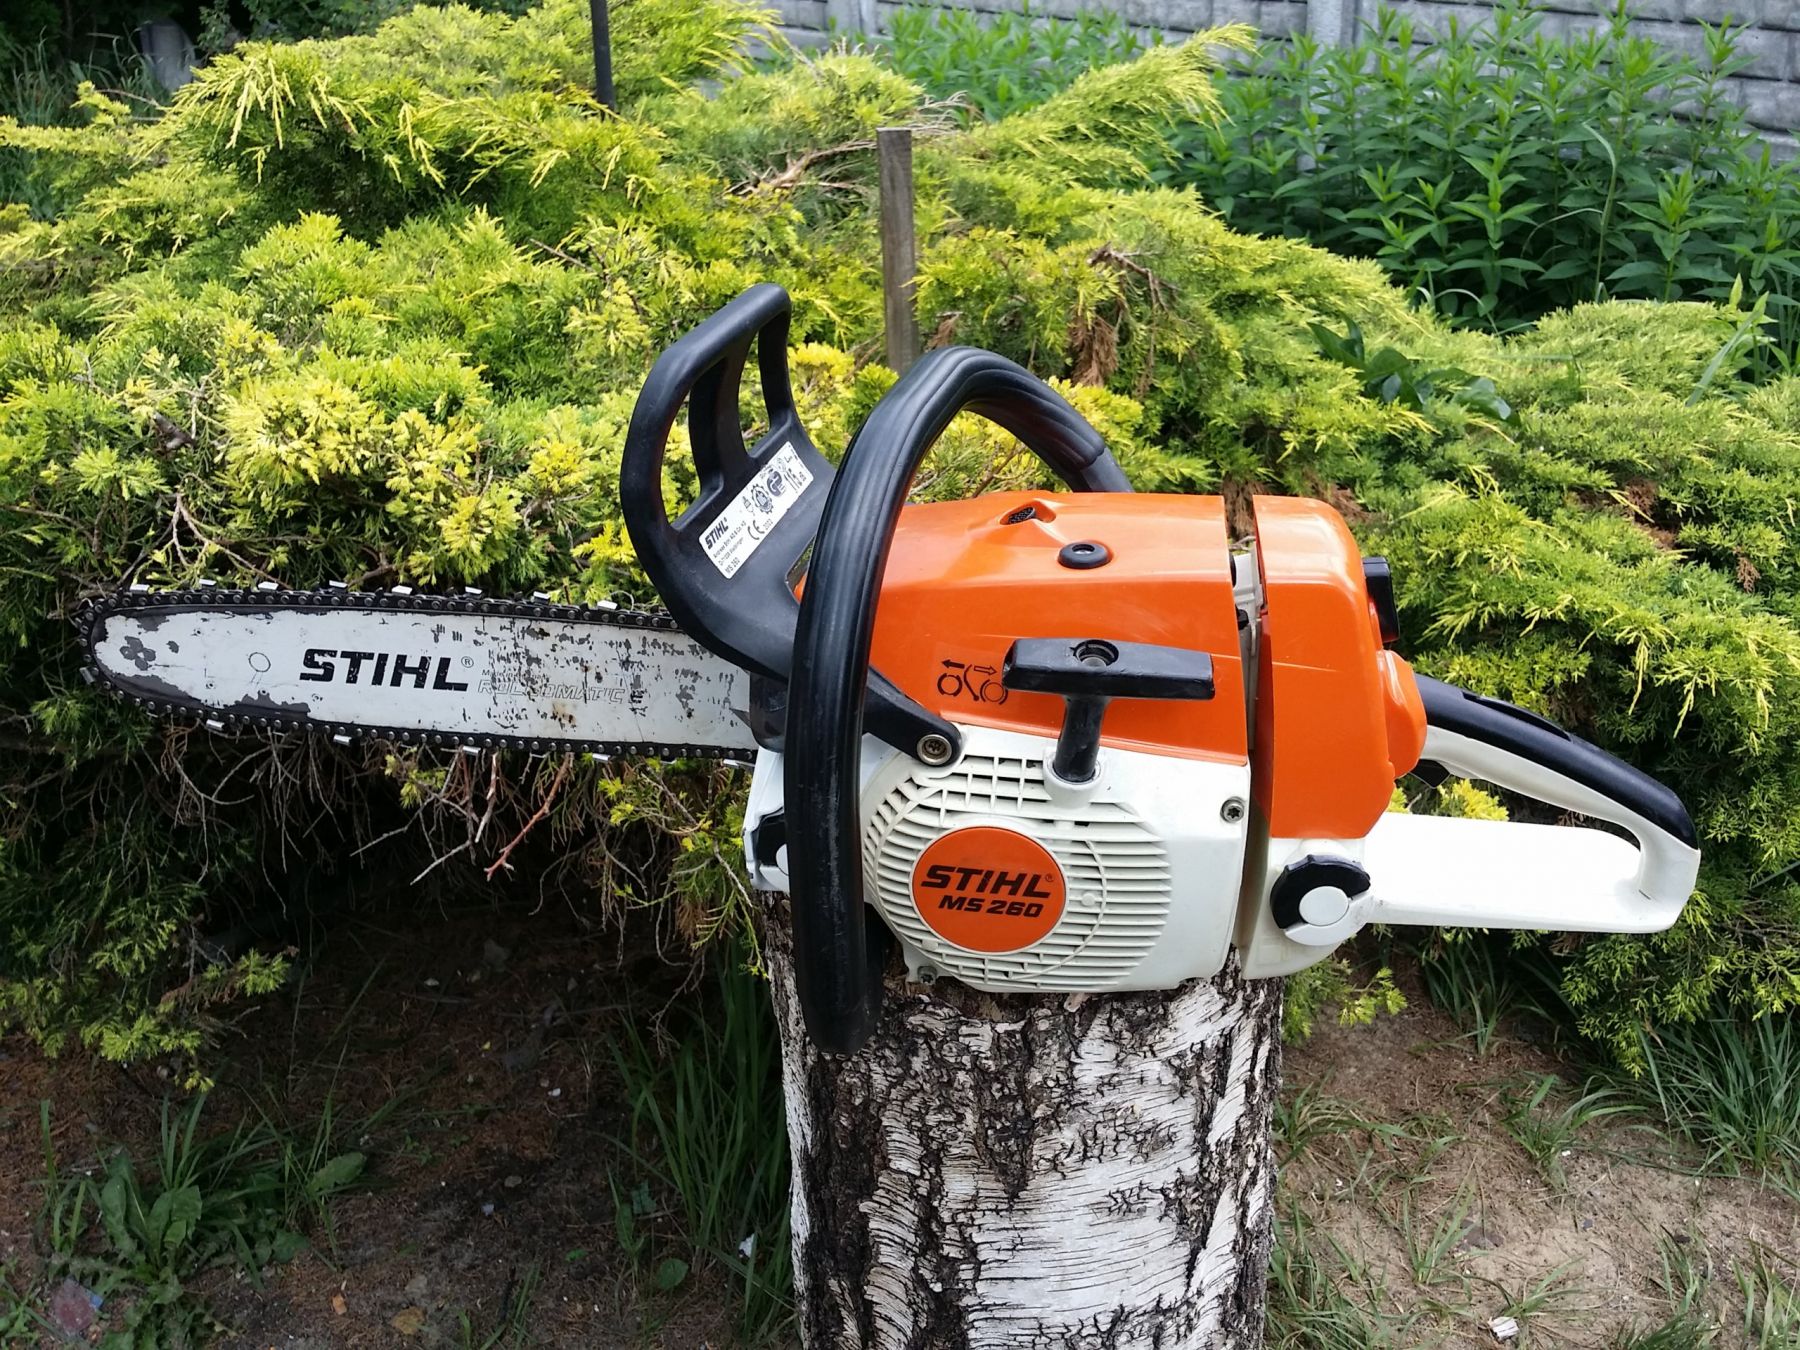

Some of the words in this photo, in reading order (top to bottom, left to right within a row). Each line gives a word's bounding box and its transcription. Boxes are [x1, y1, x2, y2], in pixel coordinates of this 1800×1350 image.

[704, 525, 729, 550] STIHL
[299, 648, 468, 692] STIHL
[920, 864, 1051, 899] STIHL
[938, 895, 986, 913] MS
[986, 900, 1045, 918] 260
